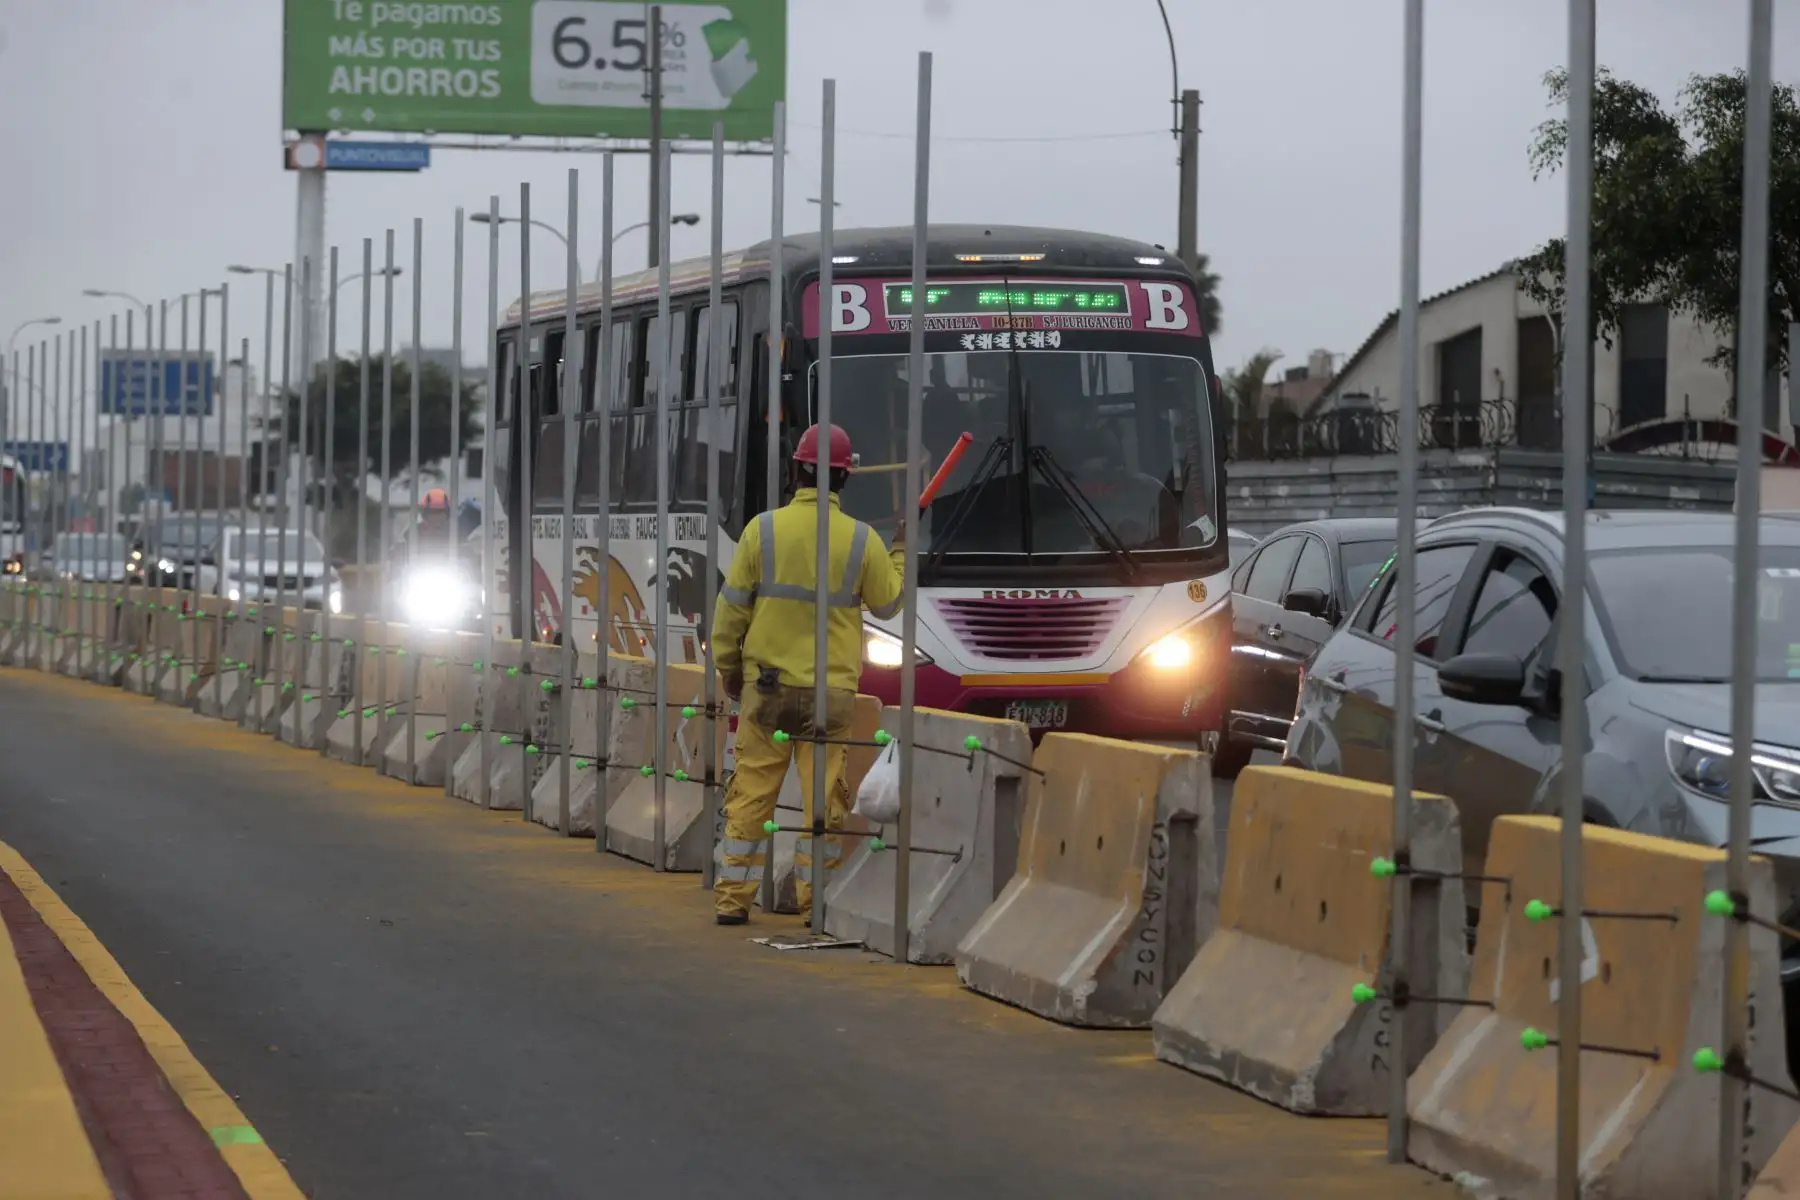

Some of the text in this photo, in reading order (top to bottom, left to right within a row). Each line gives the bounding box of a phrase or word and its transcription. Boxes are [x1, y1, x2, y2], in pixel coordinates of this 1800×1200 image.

[332, 0, 502, 29] Te pagamos
[328, 30, 502, 61] MÁS POR TUS
[552, 17, 648, 70] 6.5
[328, 65, 502, 98] AHORROS
[830, 283, 871, 332] B
[1140, 281, 1189, 330] B
[888, 317, 980, 331] VEANILLA
[675, 517, 707, 540] VENTANILL
[982, 589, 1083, 599] ROMA
[1189, 583, 1206, 599] 136
